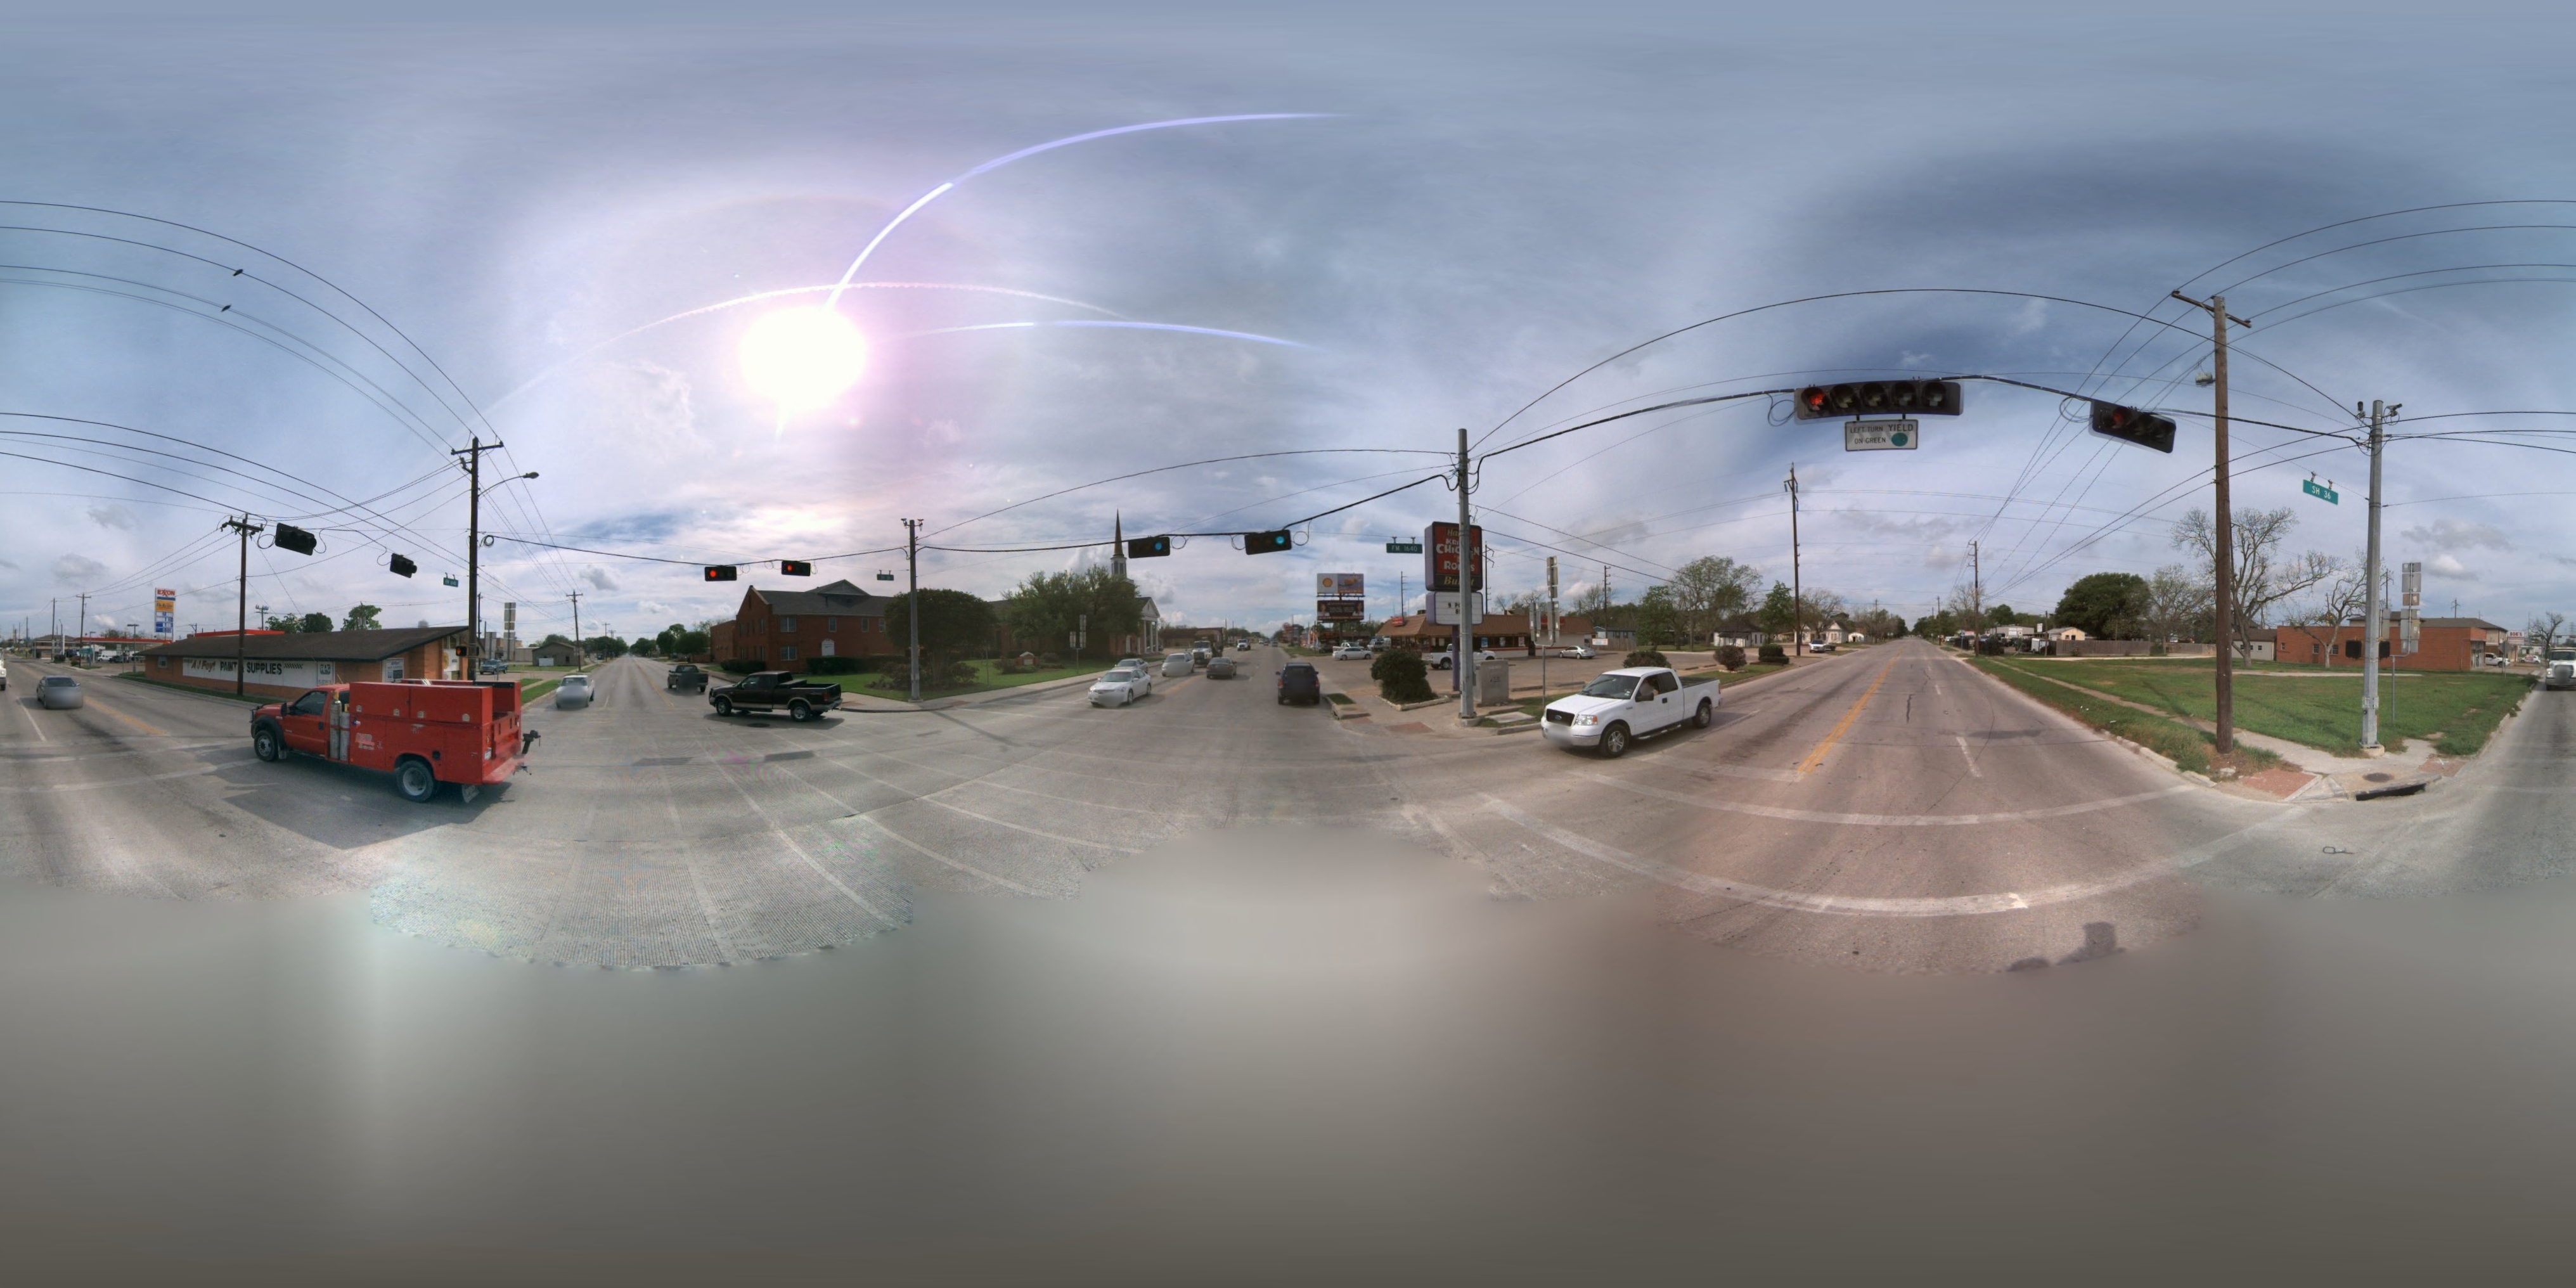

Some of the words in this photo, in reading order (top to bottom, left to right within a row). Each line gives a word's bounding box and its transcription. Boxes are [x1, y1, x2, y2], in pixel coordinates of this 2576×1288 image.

[1888, 423, 1914, 432] YIELD
[2312, 486, 2320, 495] SH
[2324, 490, 2331, 499] 36
[1443, 560, 1475, 572] ROS
[1443, 576, 1475, 586] But
[220, 660, 238, 671] PAINT
[247, 662, 282, 675] SUPPLIES
